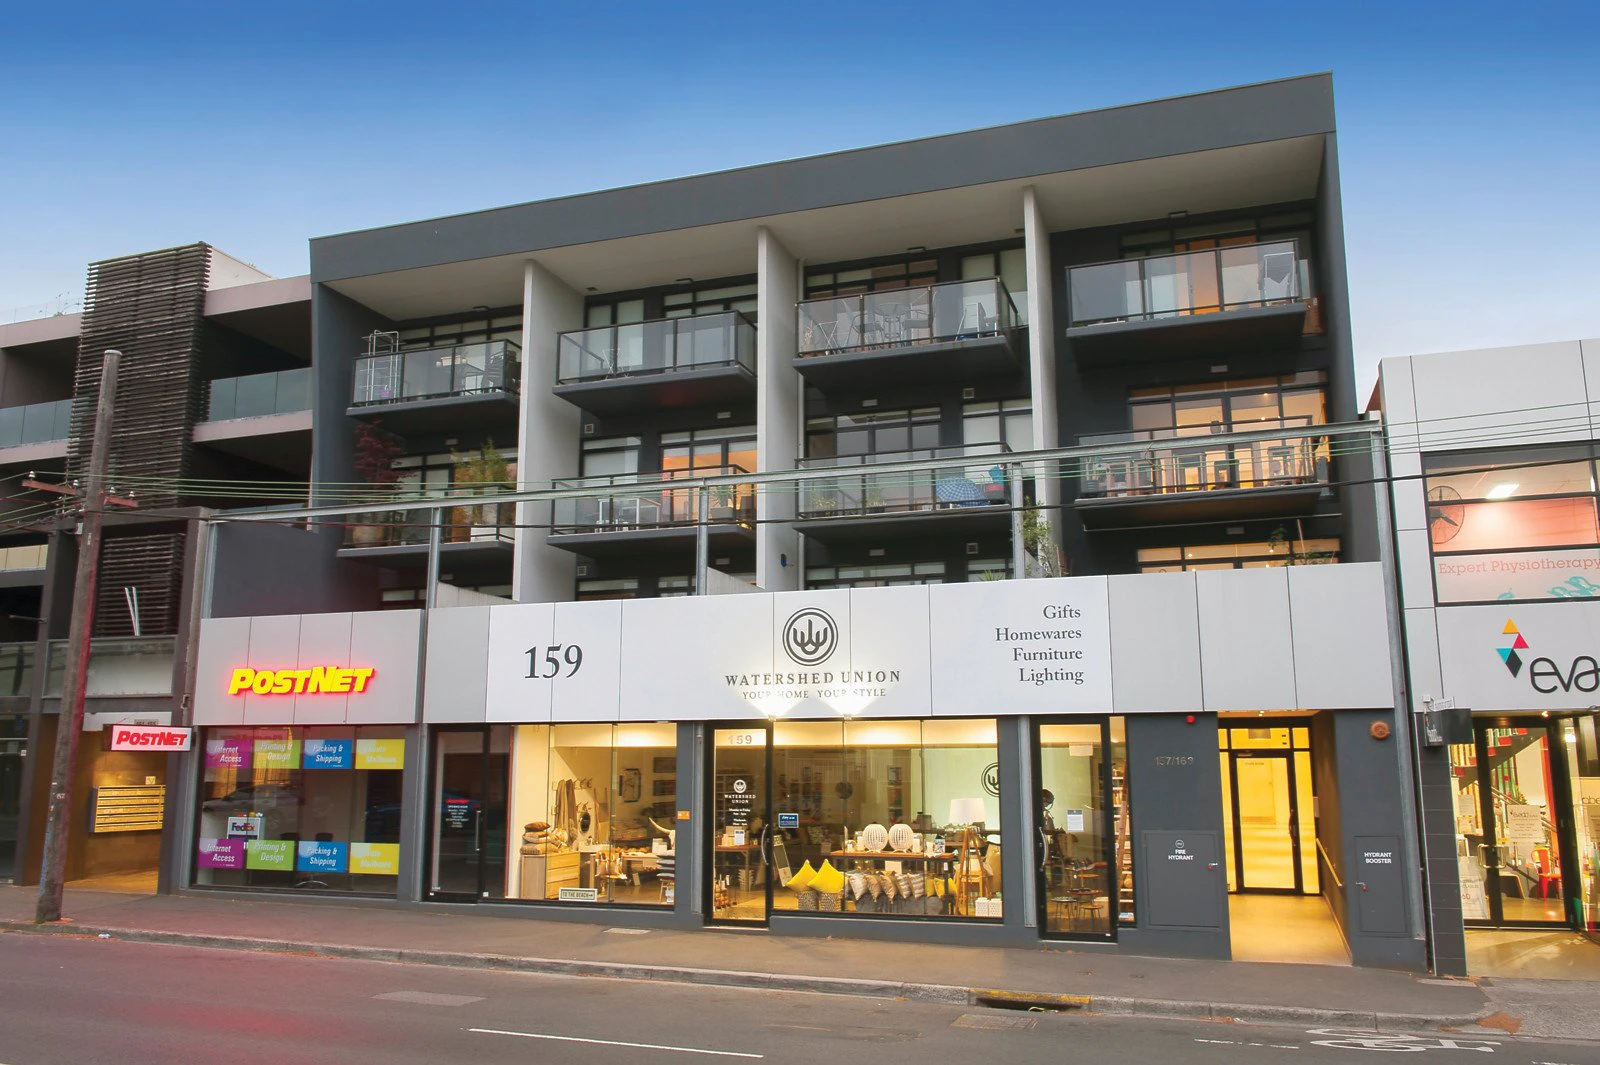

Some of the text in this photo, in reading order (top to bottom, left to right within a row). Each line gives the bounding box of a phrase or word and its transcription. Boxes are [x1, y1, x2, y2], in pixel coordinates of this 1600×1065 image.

[1439, 557, 1600, 575] Expert Physiotherapy
[1043, 604, 1081, 619] Gifts
[995, 627, 1082, 641] Homewares
[1013, 647, 1083, 661] Furniture
[524, 643, 583, 679] 159
[725, 670, 901, 687] WATERSHED UNION
[1019, 667, 1084, 686] Lighting
[728, 735, 753, 745] 159
[214, 746, 239, 754] Internet
[313, 745, 336, 753] Packing
[220, 754, 242, 763] Access
[315, 754, 342, 764] Shipping
[231, 822, 255, 832] FedEx
[206, 843, 232, 853] Internet
[254, 842, 279, 852] Printing
[307, 847, 331, 856] Packing
[212, 853, 235, 862] Access
[260, 852, 284, 863] Design
[309, 857, 337, 867] Shipping
